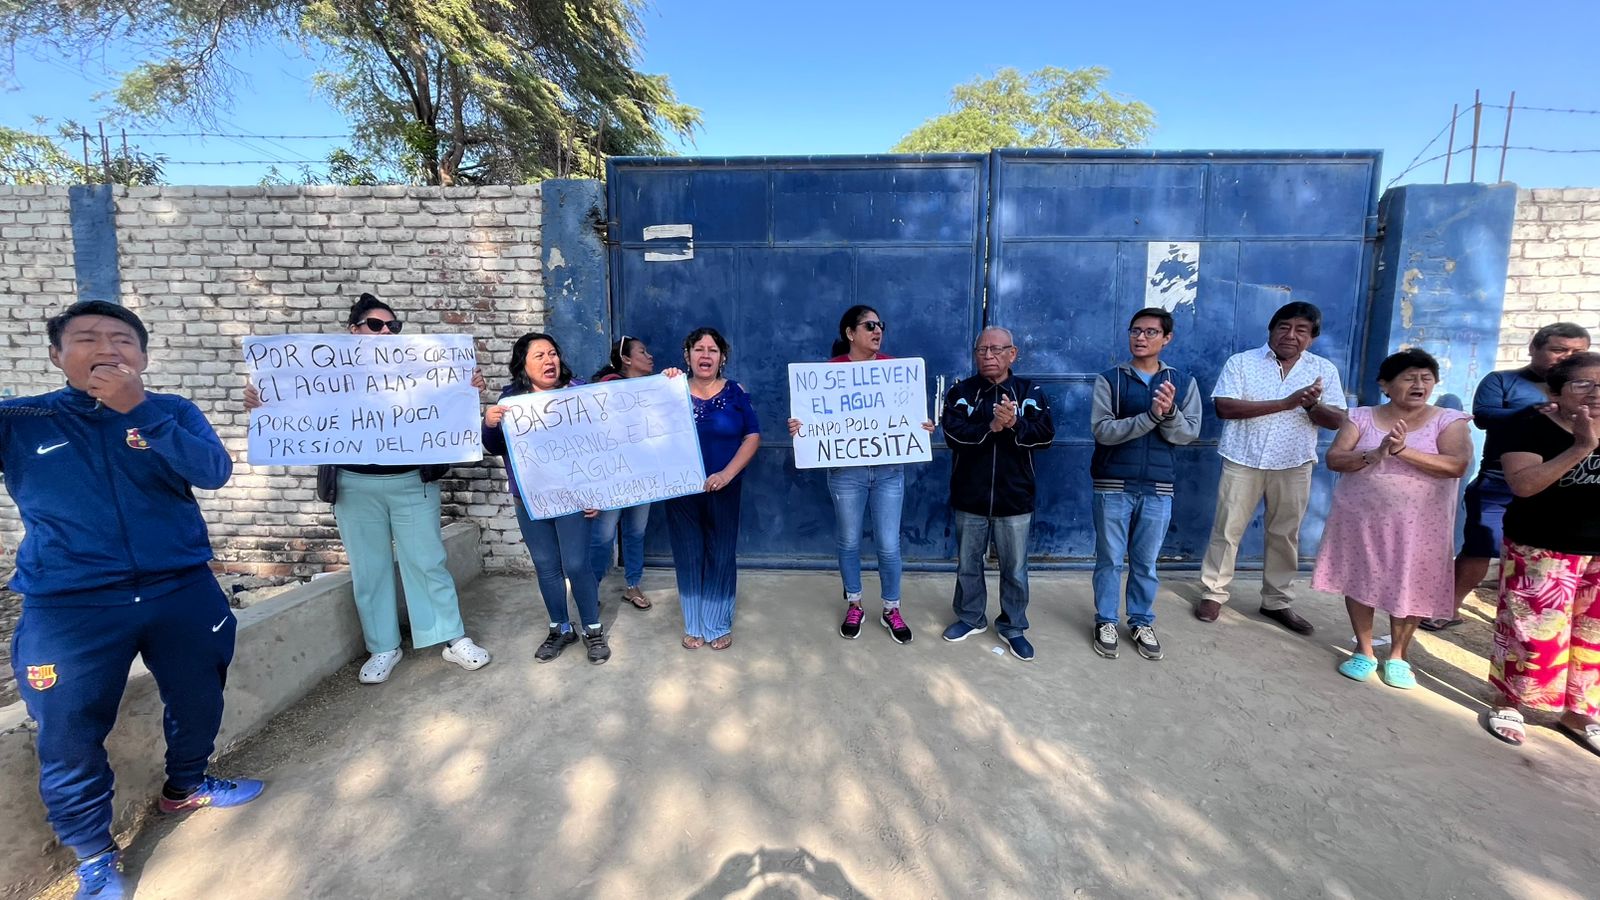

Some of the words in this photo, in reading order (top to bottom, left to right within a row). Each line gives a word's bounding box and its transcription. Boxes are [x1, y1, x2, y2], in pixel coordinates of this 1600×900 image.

[246, 342, 304, 370] POR
[310, 338, 367, 369] QUÉ
[374, 346, 418, 365] NOS
[423, 346, 475, 363] CORTAN
[258, 375, 286, 403] EL
[295, 373, 355, 399] AGUA
[795, 370, 818, 393] NO
[823, 370, 846, 390] SE
[852, 364, 919, 387] LLEVEN
[611, 388, 658, 414] DE
[811, 395, 833, 415] EL
[840, 391, 886, 412] AGUA
[351, 406, 386, 433] HAY
[391, 404, 440, 428] POCA
[797, 421, 841, 438] CAMPO
[845, 417, 879, 434] POLO
[888, 414, 910, 430] LA
[376, 435, 414, 453] DEL
[513, 429, 619, 469] ROBARNOS
[626, 415, 686, 444] EL
[567, 451, 633, 482] AGUA
